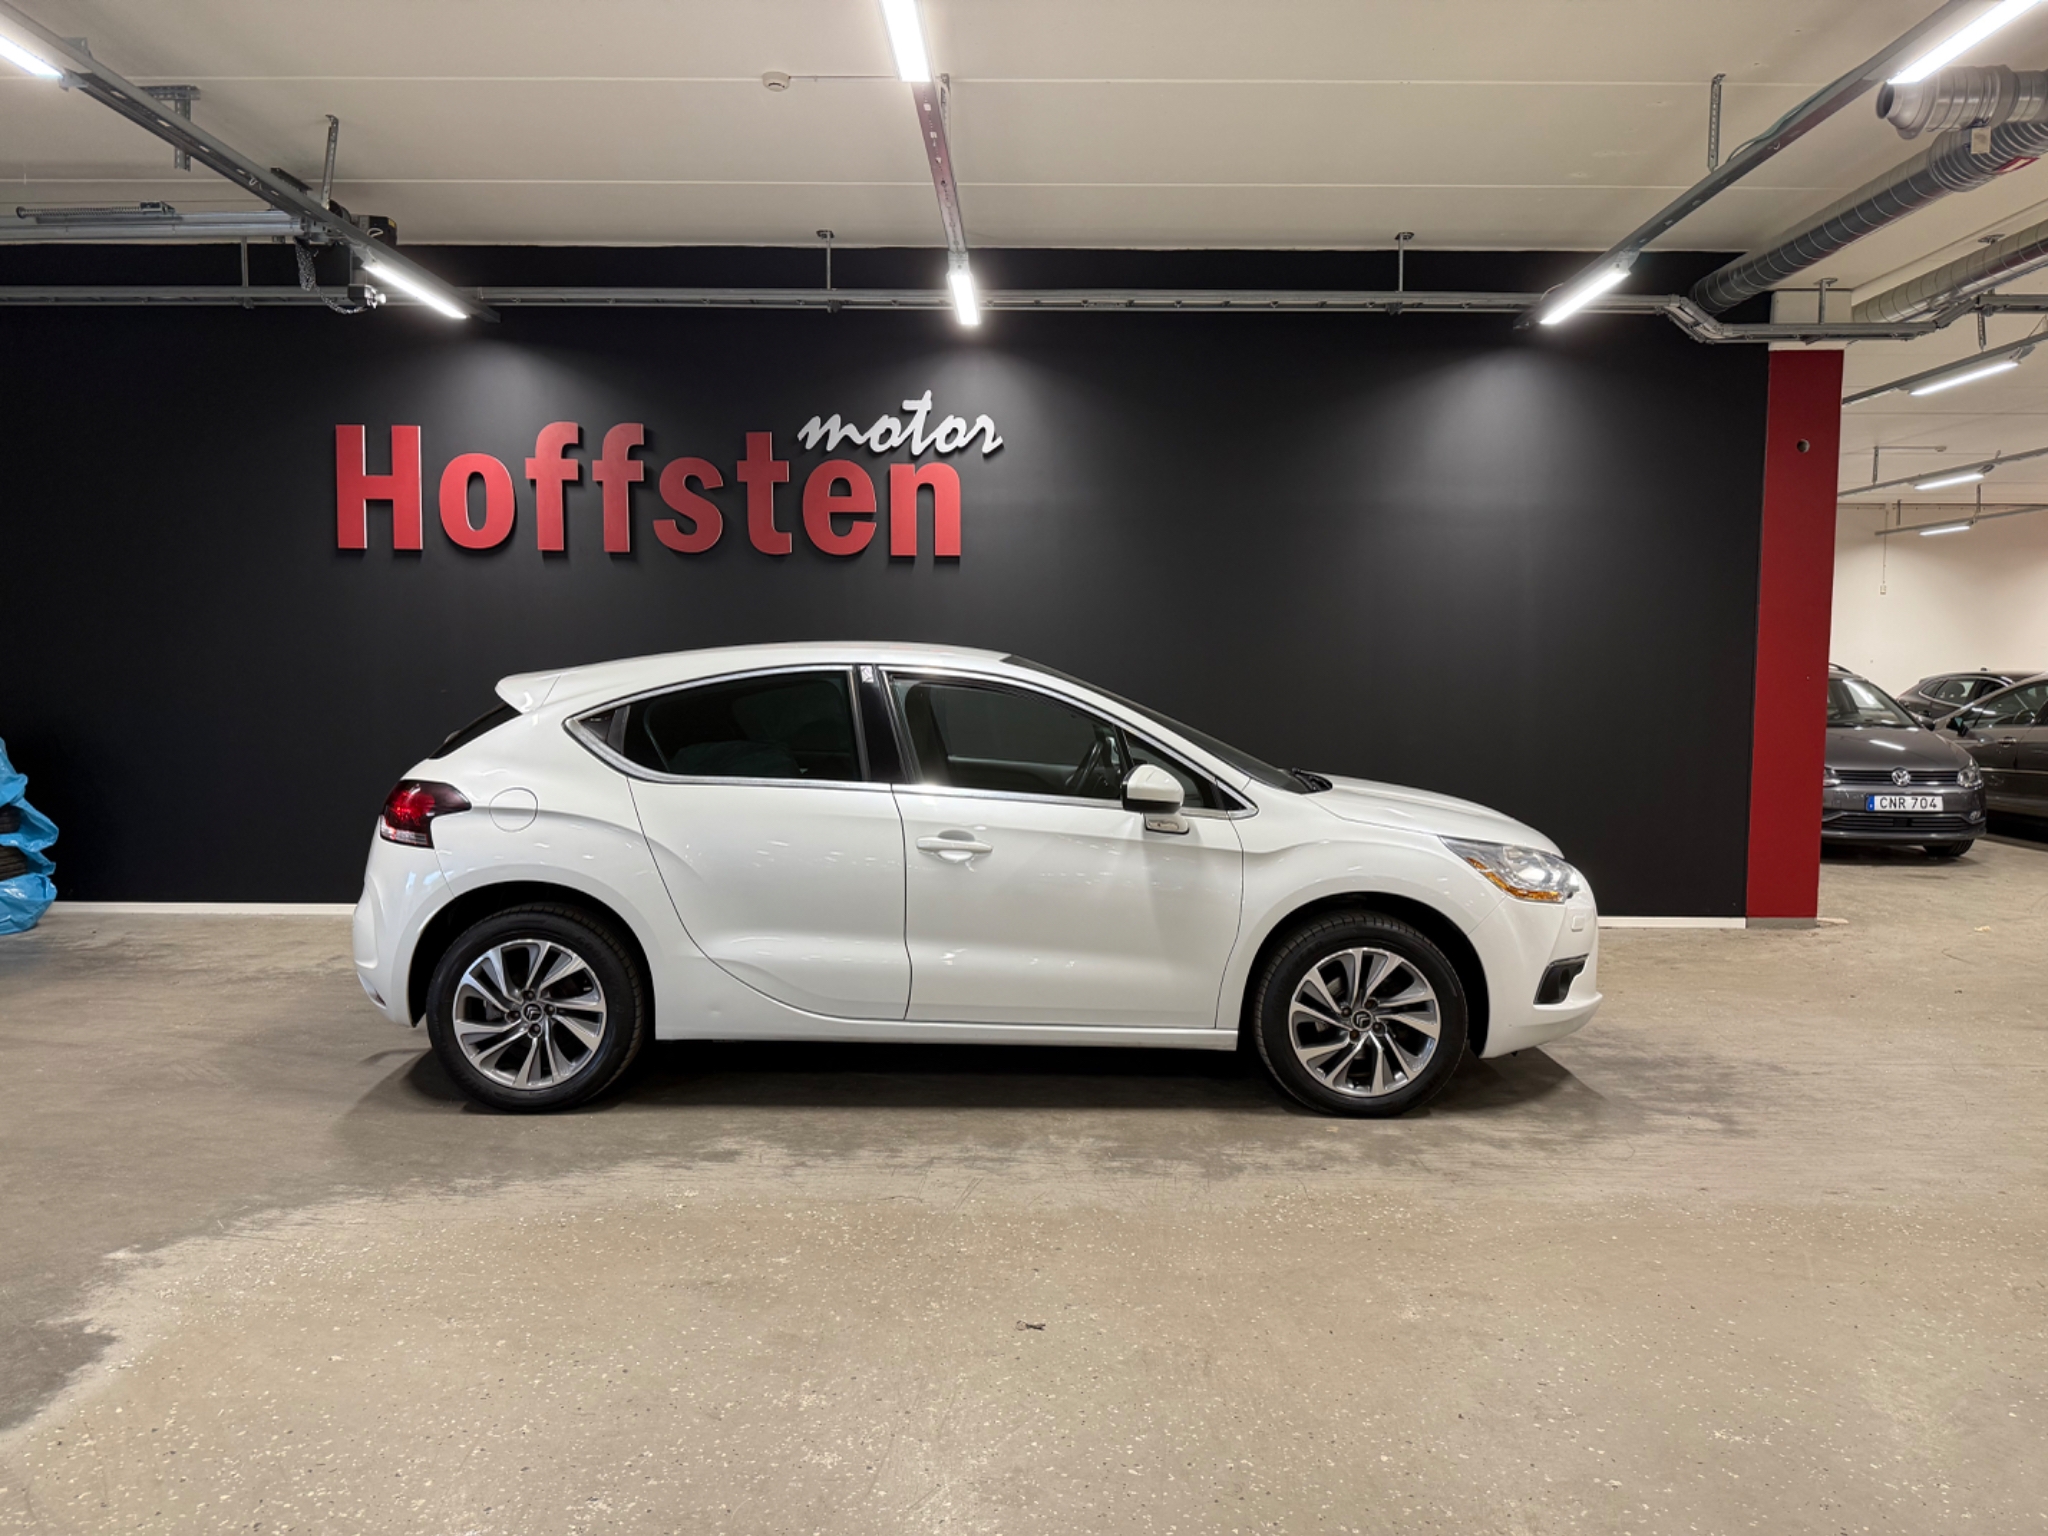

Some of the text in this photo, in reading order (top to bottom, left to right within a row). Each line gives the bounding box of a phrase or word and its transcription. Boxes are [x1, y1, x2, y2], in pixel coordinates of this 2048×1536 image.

[797, 390, 1002, 455] motor
[335, 421, 962, 557] Hoffsten
[1880, 796, 1937, 810] CNR 704
